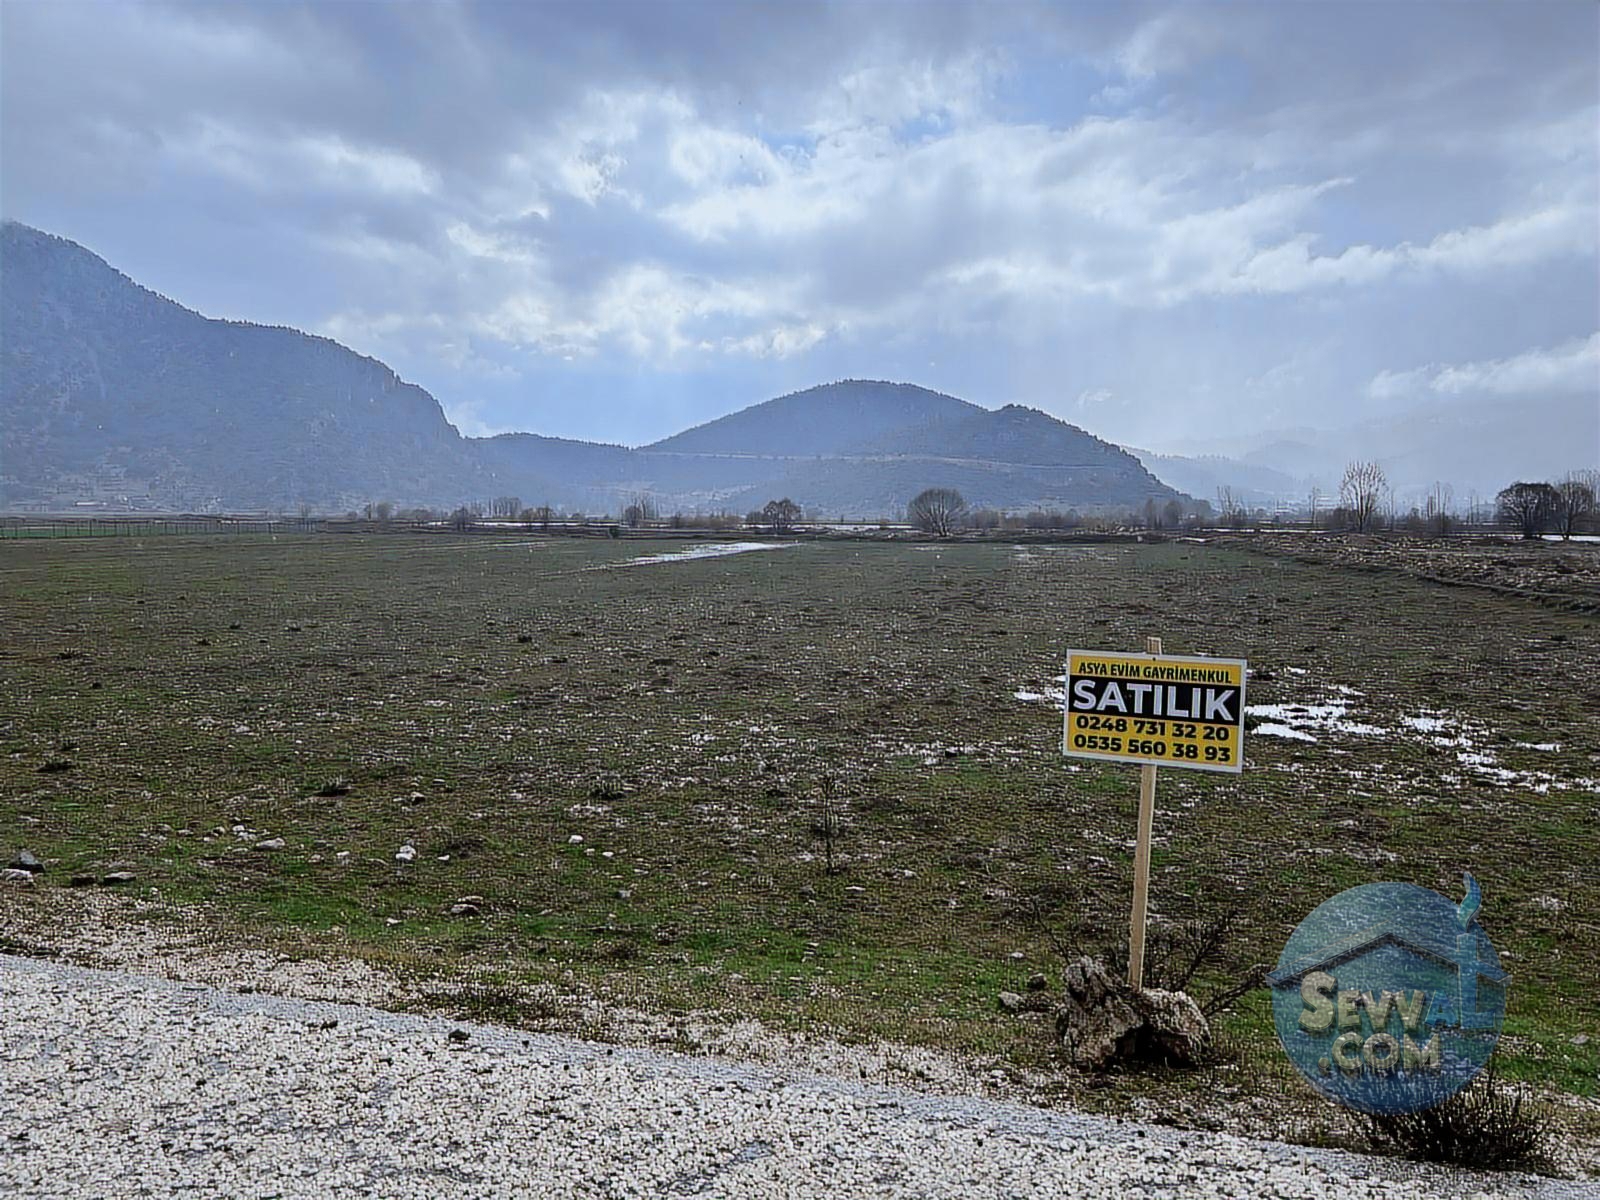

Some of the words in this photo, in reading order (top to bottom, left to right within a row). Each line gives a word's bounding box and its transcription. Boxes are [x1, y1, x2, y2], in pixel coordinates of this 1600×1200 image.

[1079, 662, 1107, 675] ASYA
[1110, 662, 1140, 677] EVİM
[1143, 665, 1232, 684] GAYRİMENKUL
[1073, 679, 1235, 721] SATILIK
[1076, 715, 1127, 732] 0248
[1133, 719, 1166, 736] 731
[1172, 723, 1196, 739] 32
[1203, 726, 1229, 741] 20
[1074, 734, 1122, 751] 0535
[1128, 739, 1166, 756] 560
[1172, 743, 1198, 759] 38
[1204, 746, 1231, 762] 93
